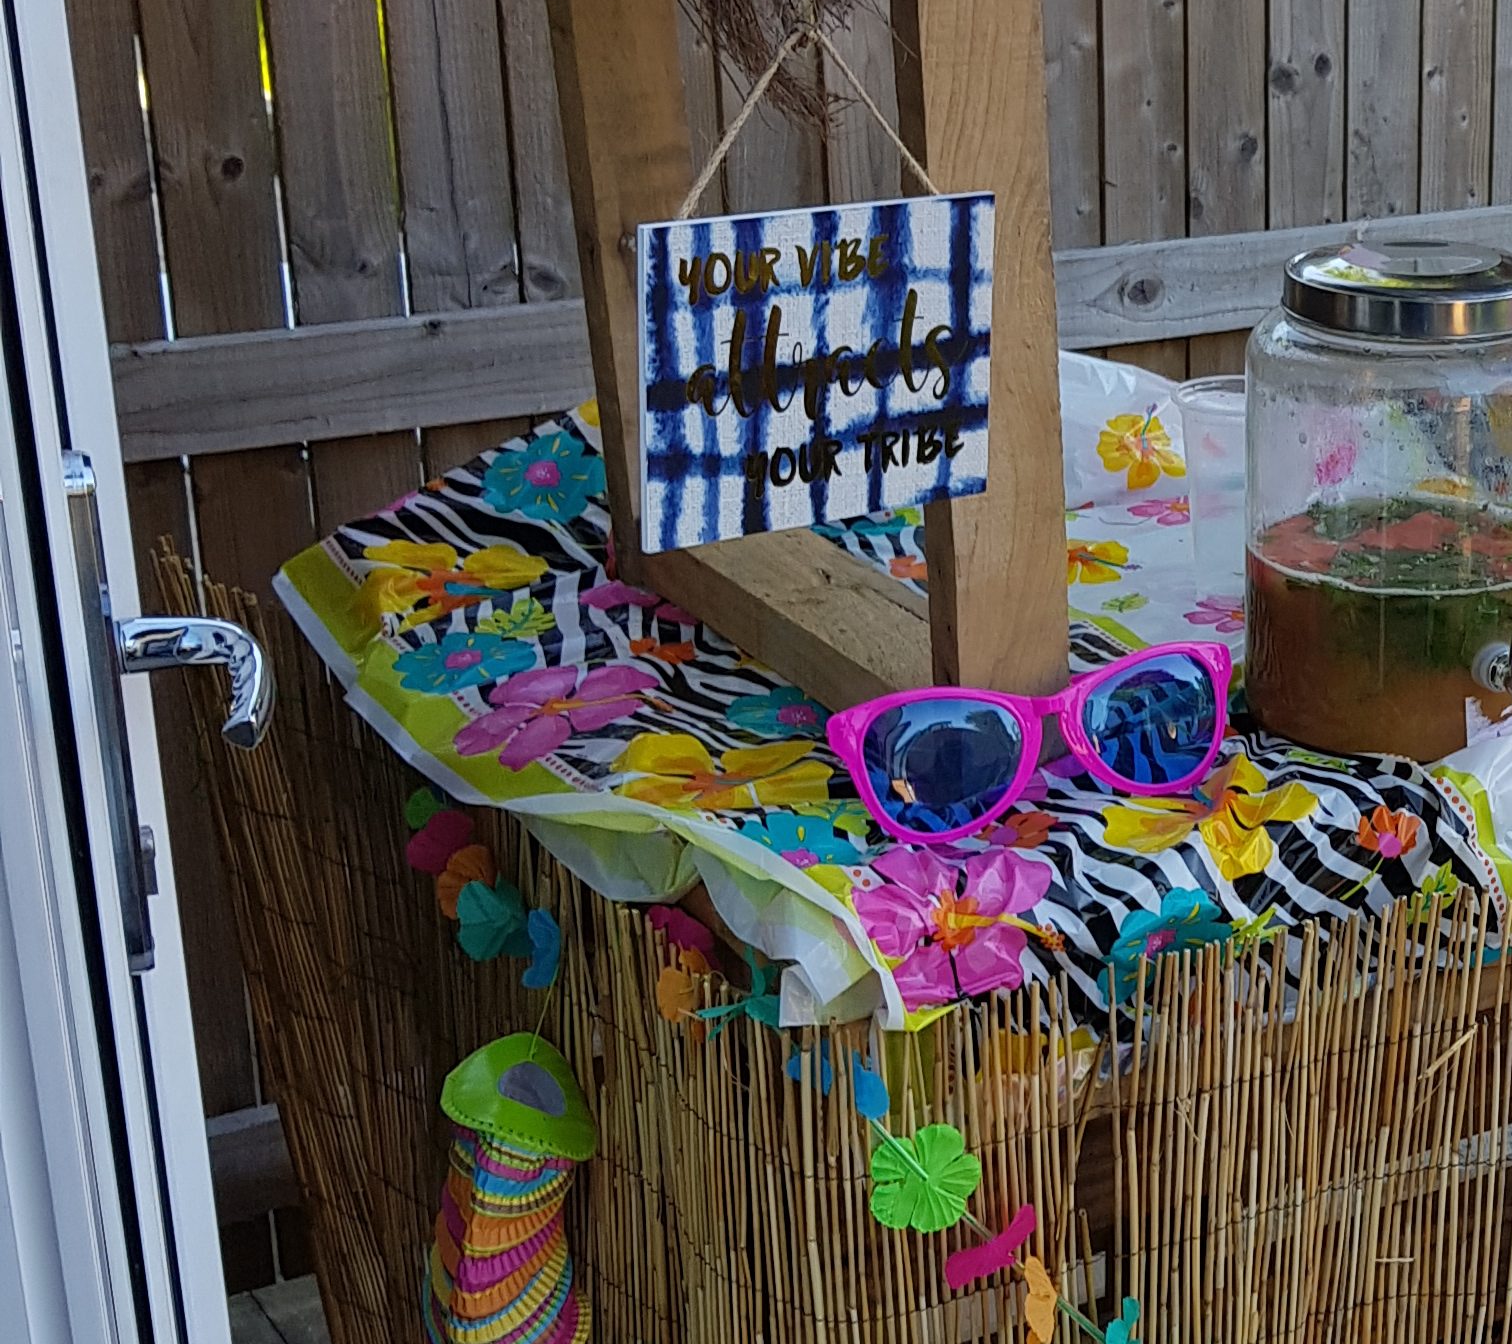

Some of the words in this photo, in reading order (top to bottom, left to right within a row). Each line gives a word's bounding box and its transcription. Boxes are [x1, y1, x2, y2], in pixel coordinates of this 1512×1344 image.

[679, 247, 781, 304] YOUR
[795, 234, 892, 286] VIBE
[685, 288, 966, 420] attracts
[744, 438, 843, 499] YOUR
[859, 420, 965, 473] TRIBE
